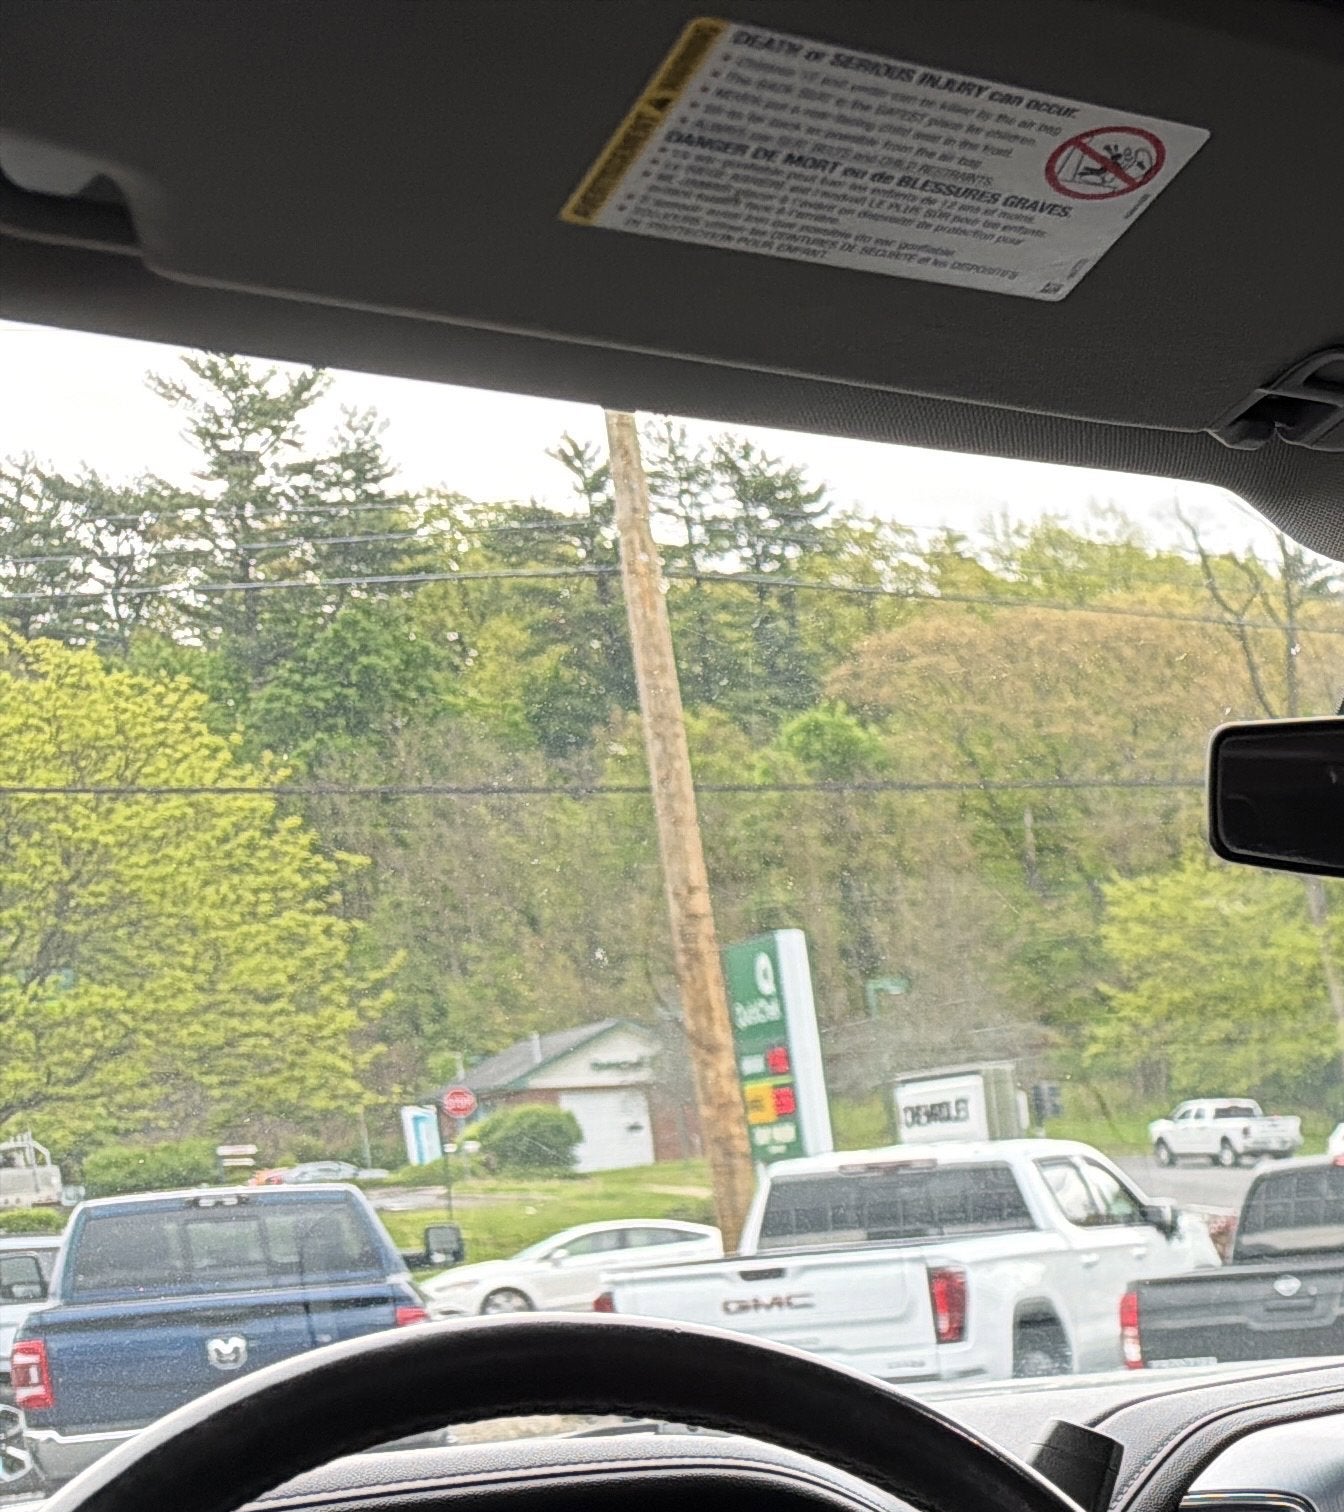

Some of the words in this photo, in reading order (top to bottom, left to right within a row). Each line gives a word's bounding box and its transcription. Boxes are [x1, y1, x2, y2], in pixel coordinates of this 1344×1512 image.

[731, 30, 805, 57] DEATH
[828, 52, 918, 83] SERIOUS
[915, 72, 989, 98] INJURY
[662, 129, 750, 156] DANGER
[782, 153, 841, 173] MORT
[895, 174, 1003, 204] BLESSURES
[722, 1291, 815, 1316] GMC
